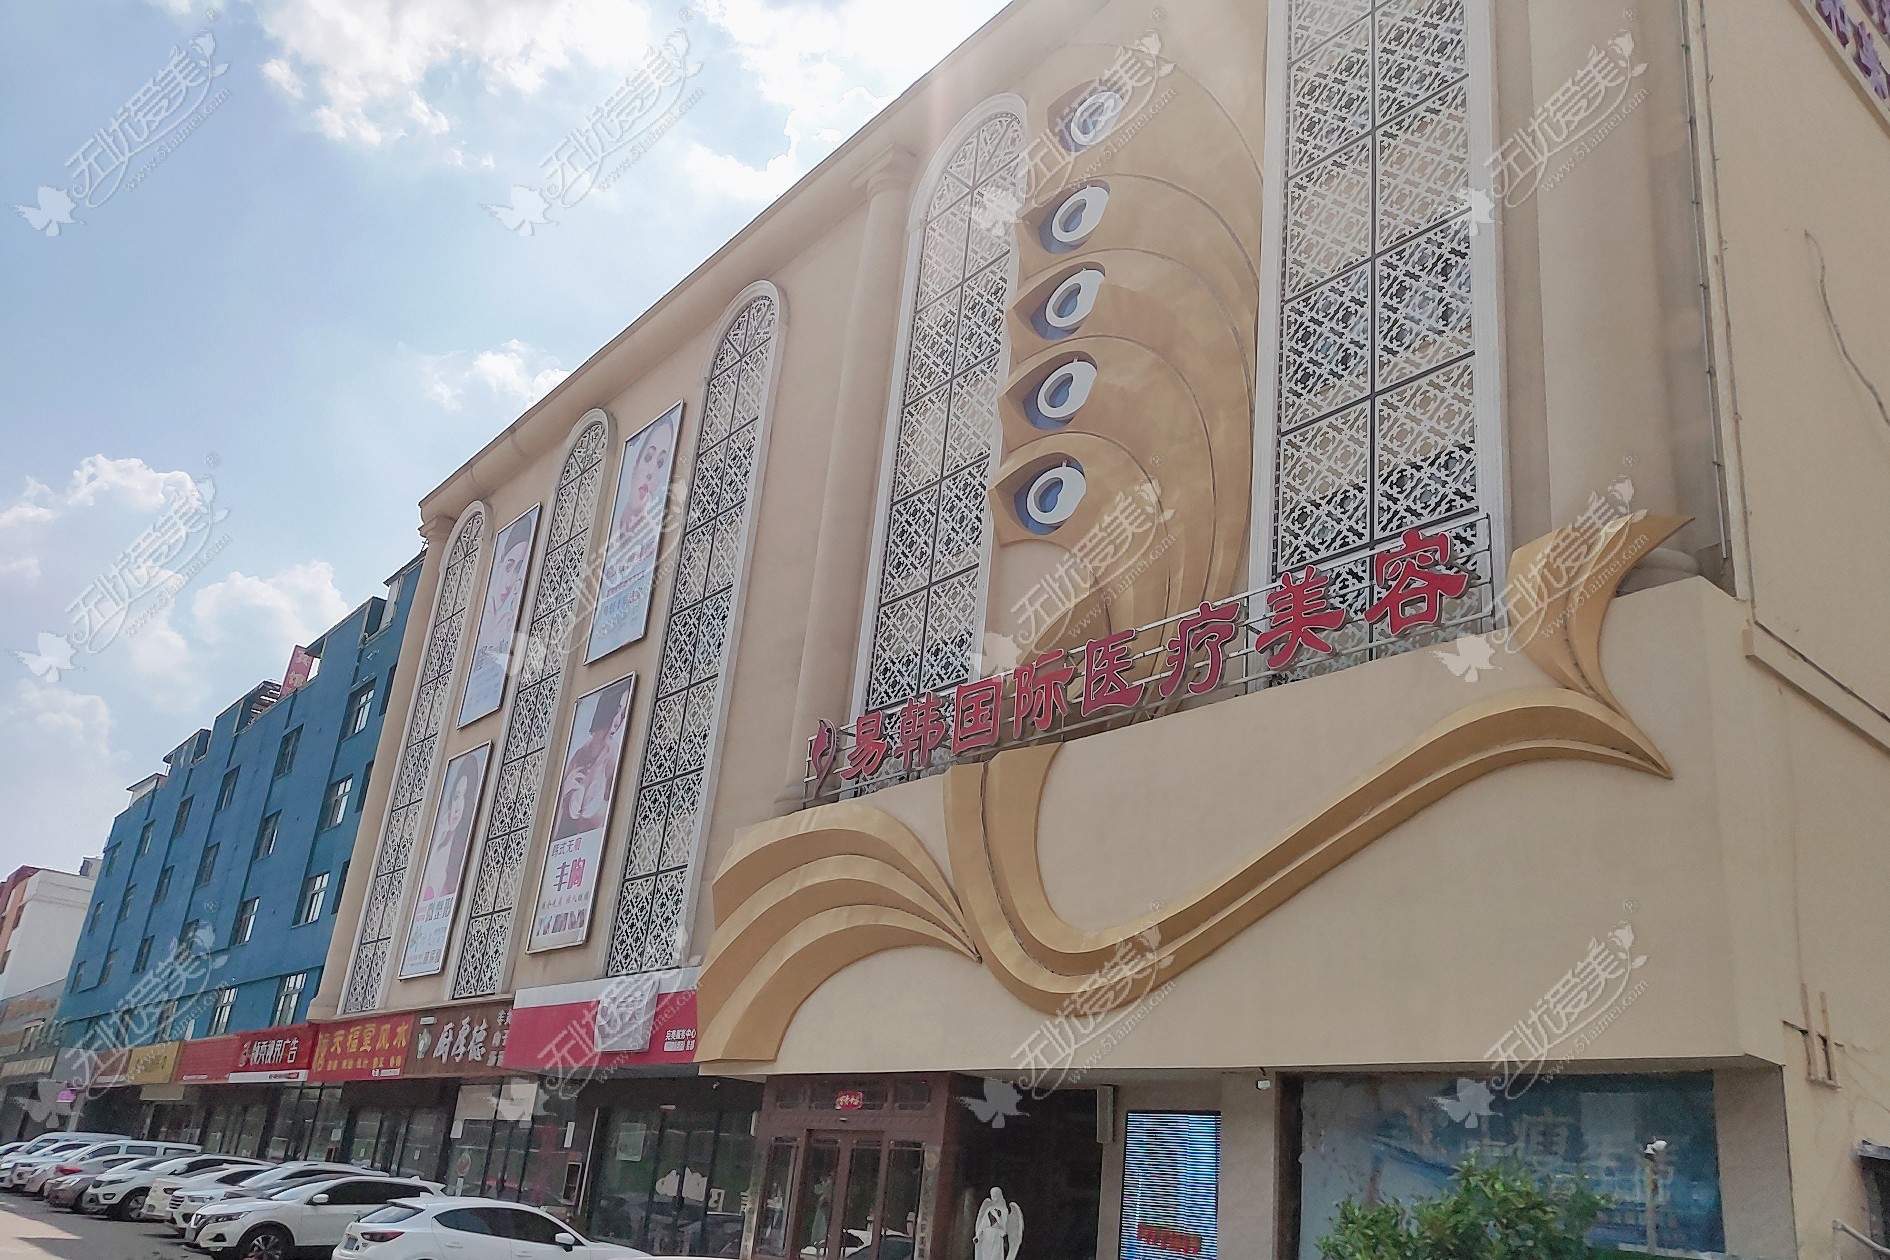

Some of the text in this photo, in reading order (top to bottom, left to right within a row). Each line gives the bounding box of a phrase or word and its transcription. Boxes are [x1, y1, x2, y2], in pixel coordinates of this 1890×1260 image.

[840, 530, 1468, 781] 易韩国际医疗美容
[552, 857, 586, 892] 丰胸
